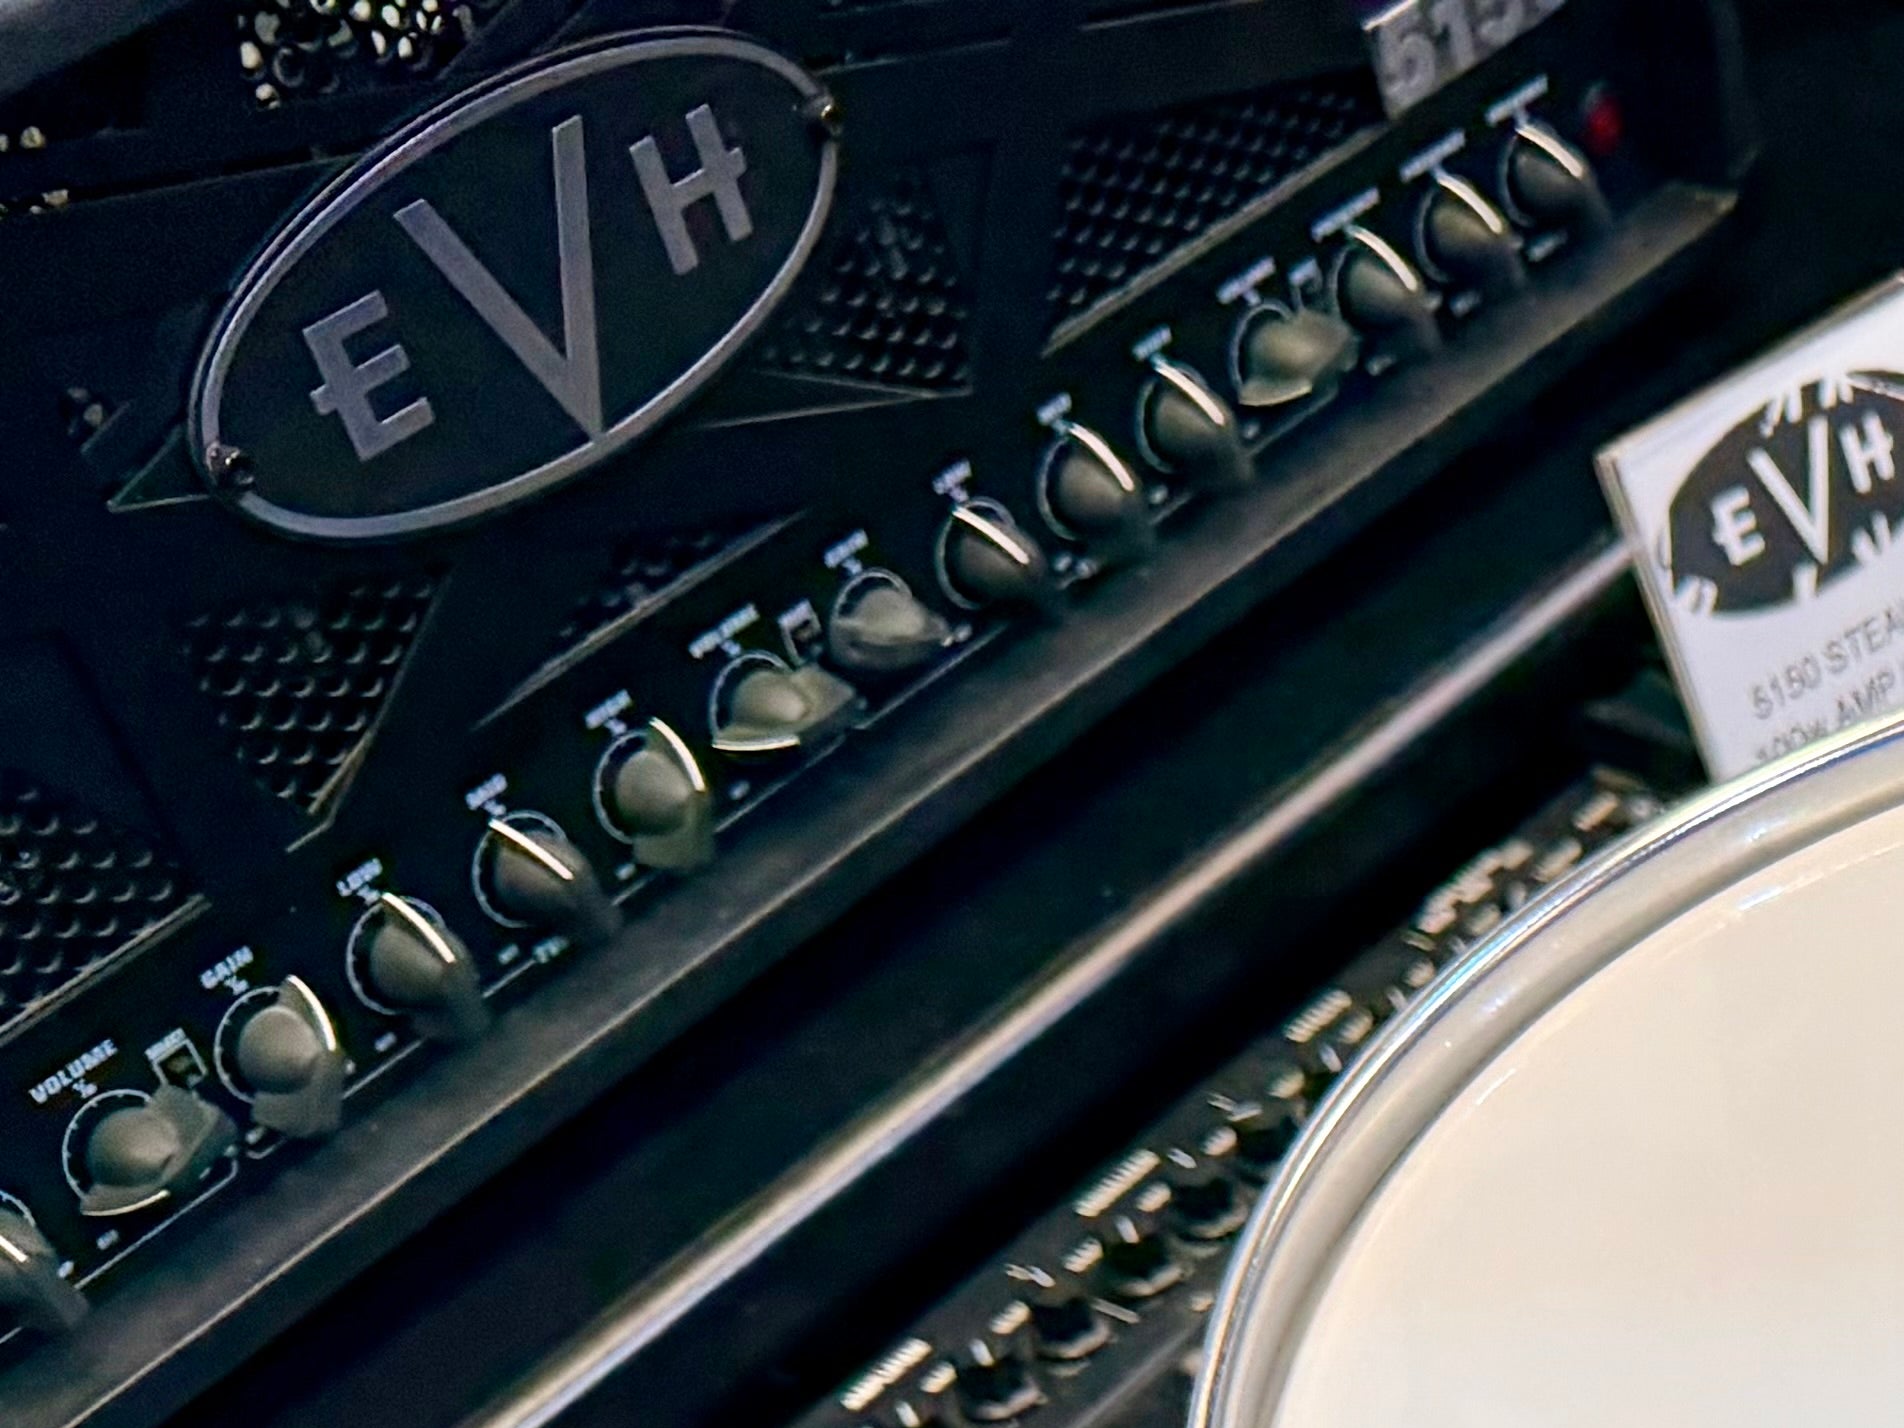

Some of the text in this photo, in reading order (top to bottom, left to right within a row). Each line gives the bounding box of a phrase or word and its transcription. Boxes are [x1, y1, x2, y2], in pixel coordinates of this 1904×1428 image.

[1380, 0, 1566, 100] 515
[300, 102, 755, 463] EVH
[1709, 410, 1896, 566] EVH
[28, 1038, 118, 1104] VOLUME
